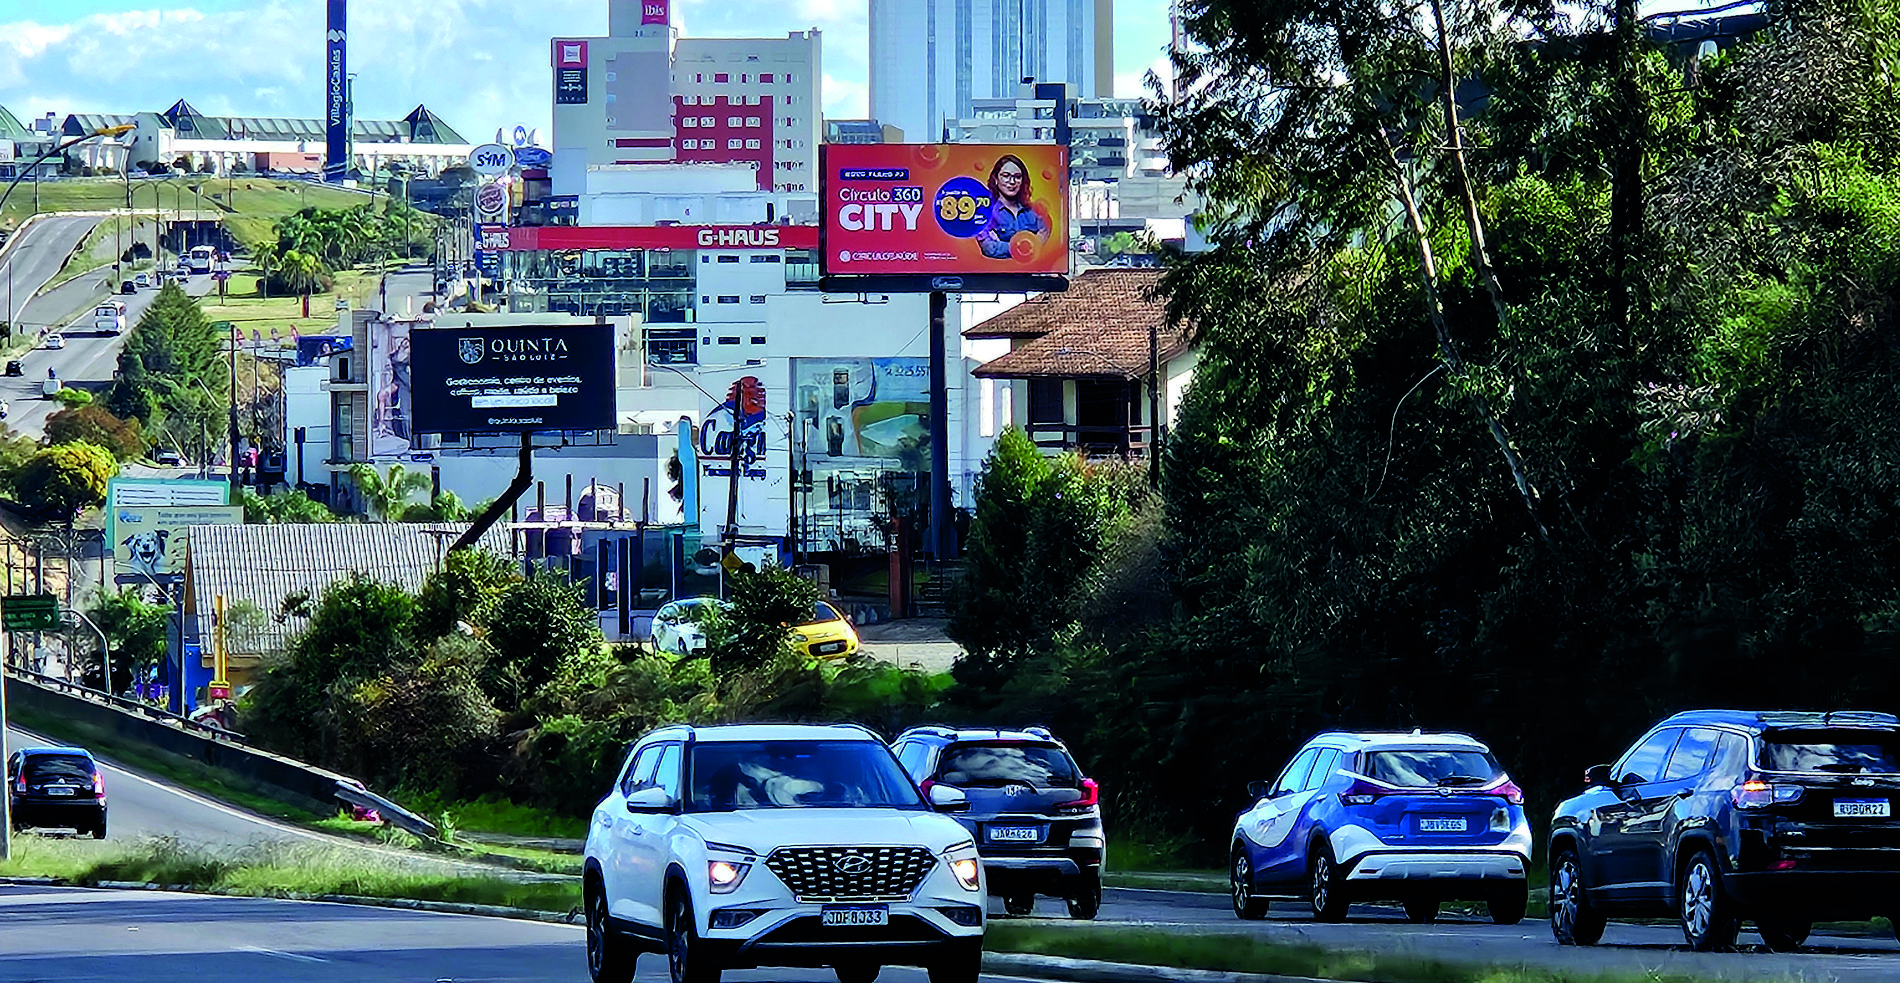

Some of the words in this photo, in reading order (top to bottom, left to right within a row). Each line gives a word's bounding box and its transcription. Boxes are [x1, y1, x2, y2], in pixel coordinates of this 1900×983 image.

[644, 5, 665, 16] ibis
[839, 187, 891, 202] Círculo
[893, 188, 921, 201] 360
[838, 203, 924, 231] CITY
[491, 337, 569, 353] QUINTA
